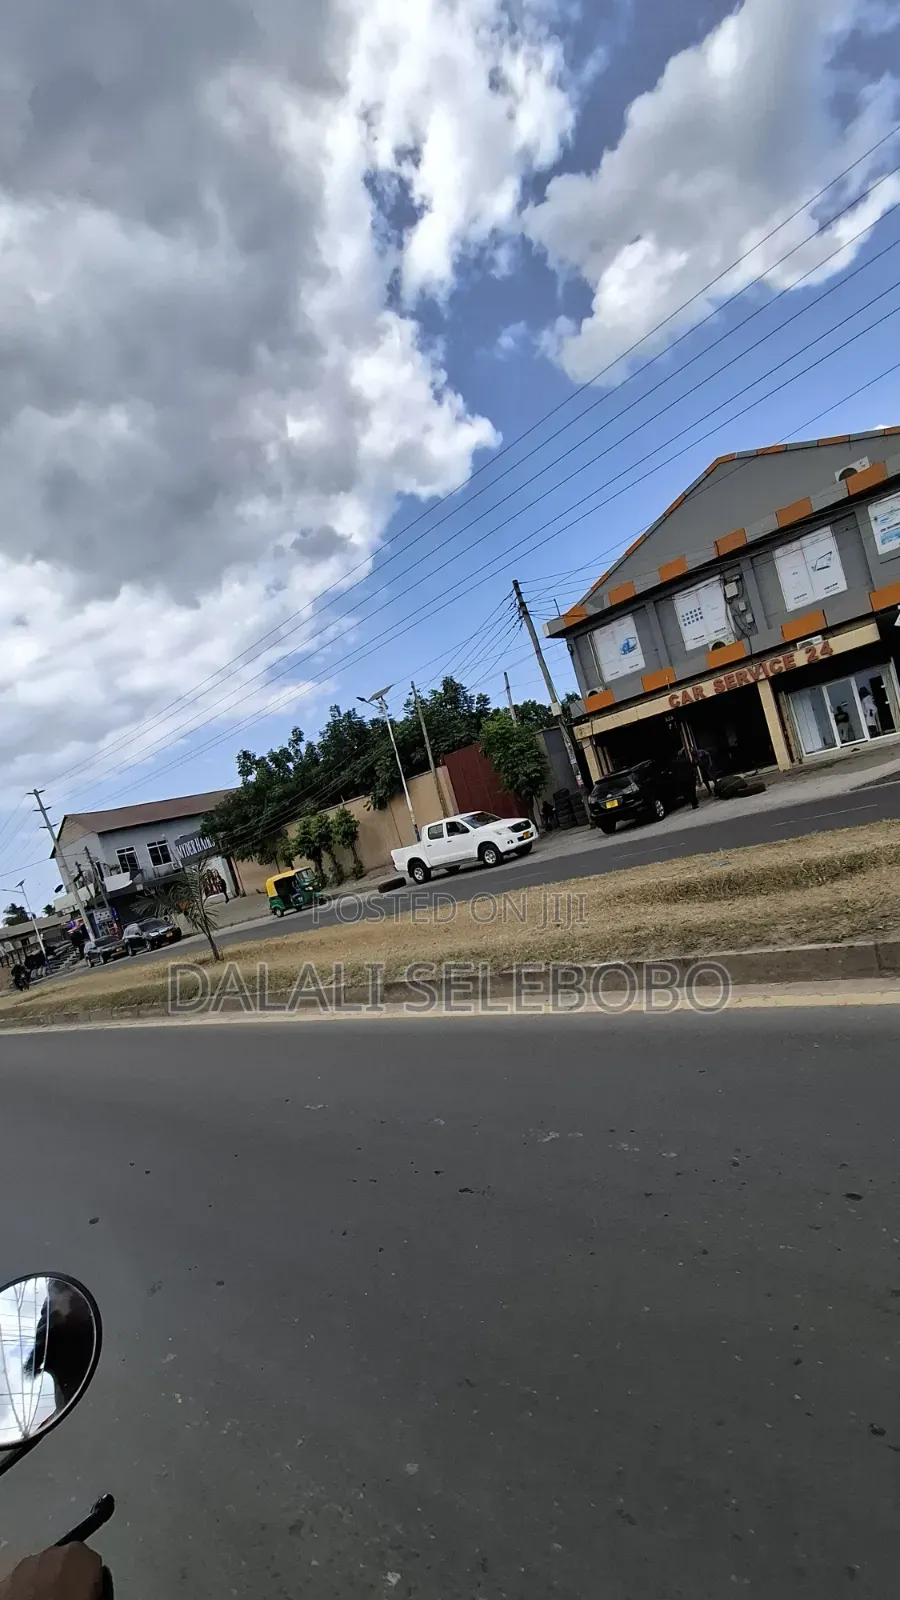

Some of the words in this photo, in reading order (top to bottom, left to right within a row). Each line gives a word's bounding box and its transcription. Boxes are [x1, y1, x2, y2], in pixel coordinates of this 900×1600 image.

[668, 685, 707, 708] CAR
[713, 653, 796, 694] SERVICE
[805, 641, 834, 663] 24
